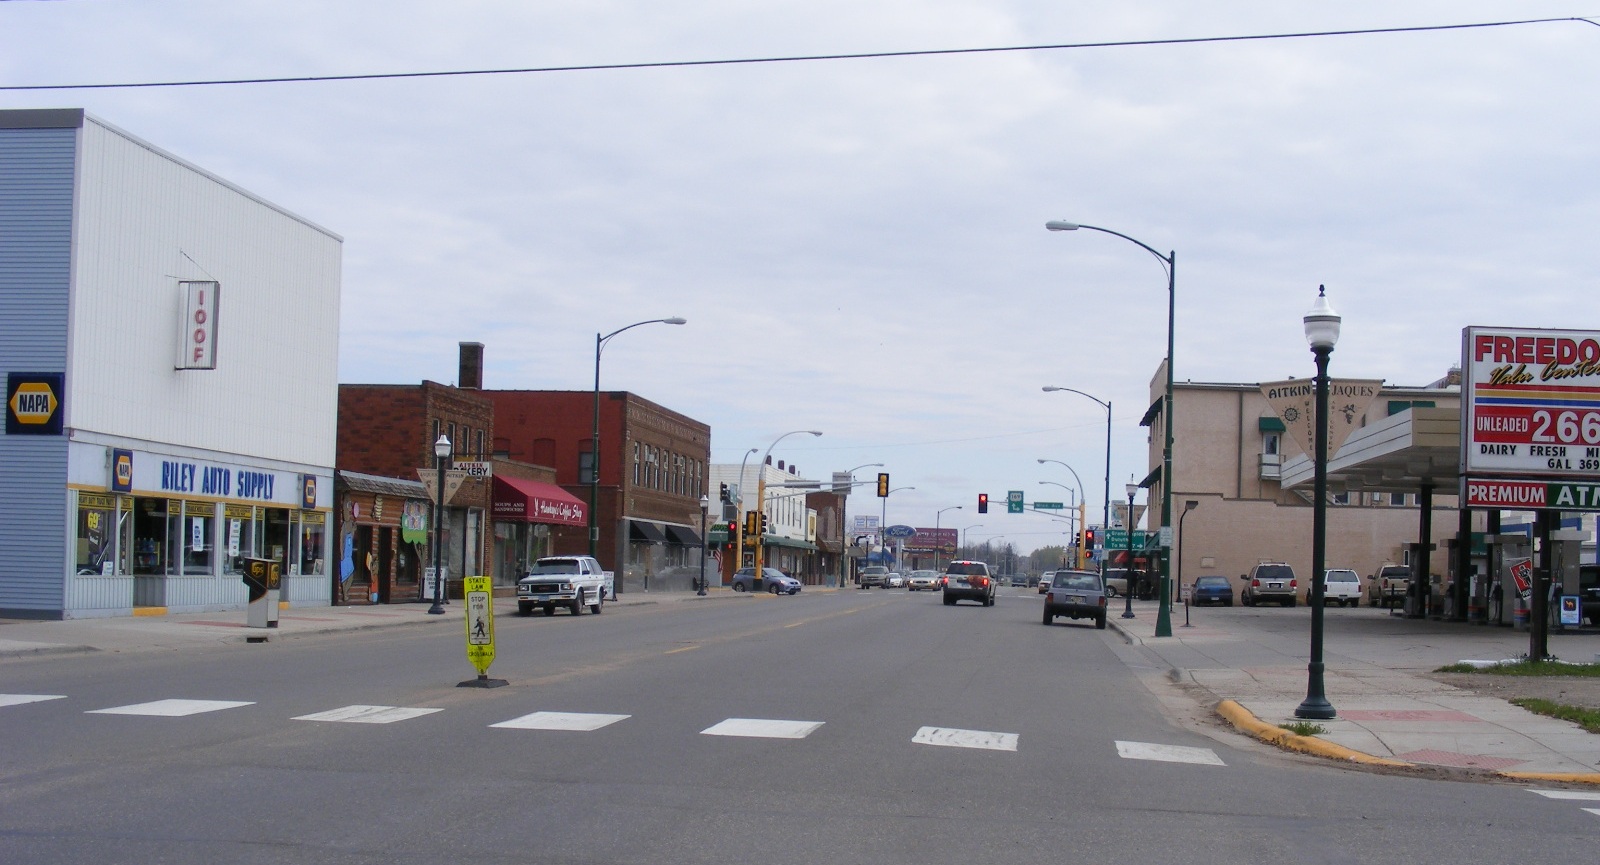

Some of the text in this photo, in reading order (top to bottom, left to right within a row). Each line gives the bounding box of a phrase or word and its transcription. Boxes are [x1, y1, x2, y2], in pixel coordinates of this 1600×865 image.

[1475, 335, 1600, 366] FREEDO
[1489, 364, 1534, 385] Valu
[1268, 385, 1311, 399] AITKIN
[1331, 385, 1374, 397] JAQUES
[19, 394, 49, 412] NAPA
[1305, 401, 1313, 451] WELCOME
[1477, 416, 1529, 433] UNLEADED
[1480, 444, 1600, 458] DAIRY FRESH MI
[119, 463, 130, 477] NAPA
[1547, 458, 1600, 470] GAL 369
[162, 460, 275, 500] RILEY AUTO SUPPLY
[1468, 484, 1545, 503] PREMIUM
[571, 504, 582, 521] Shop
[890, 527, 910, 536] Ford
